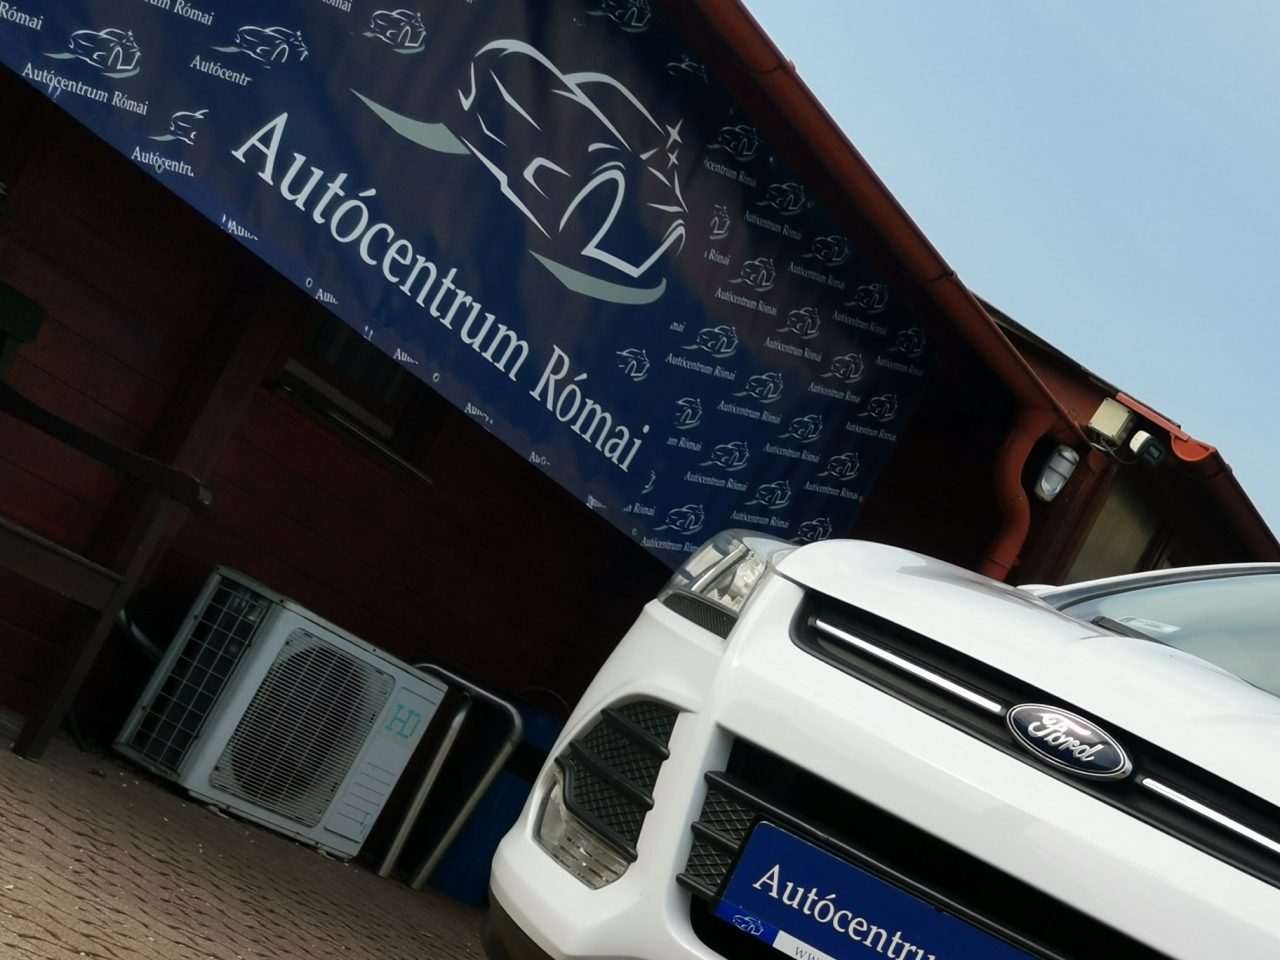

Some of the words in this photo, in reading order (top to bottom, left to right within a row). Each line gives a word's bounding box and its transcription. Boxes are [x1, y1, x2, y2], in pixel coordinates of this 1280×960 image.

[0, 1, 44, 31] Római
[173, 0, 215, 26] Római
[22, 62, 110, 103] Autócentrum
[111, 90, 149, 116] Római
[231, 111, 530, 382] Autócentrum
[528, 344, 650, 473] Római
[1027, 712, 1105, 762] Ford
